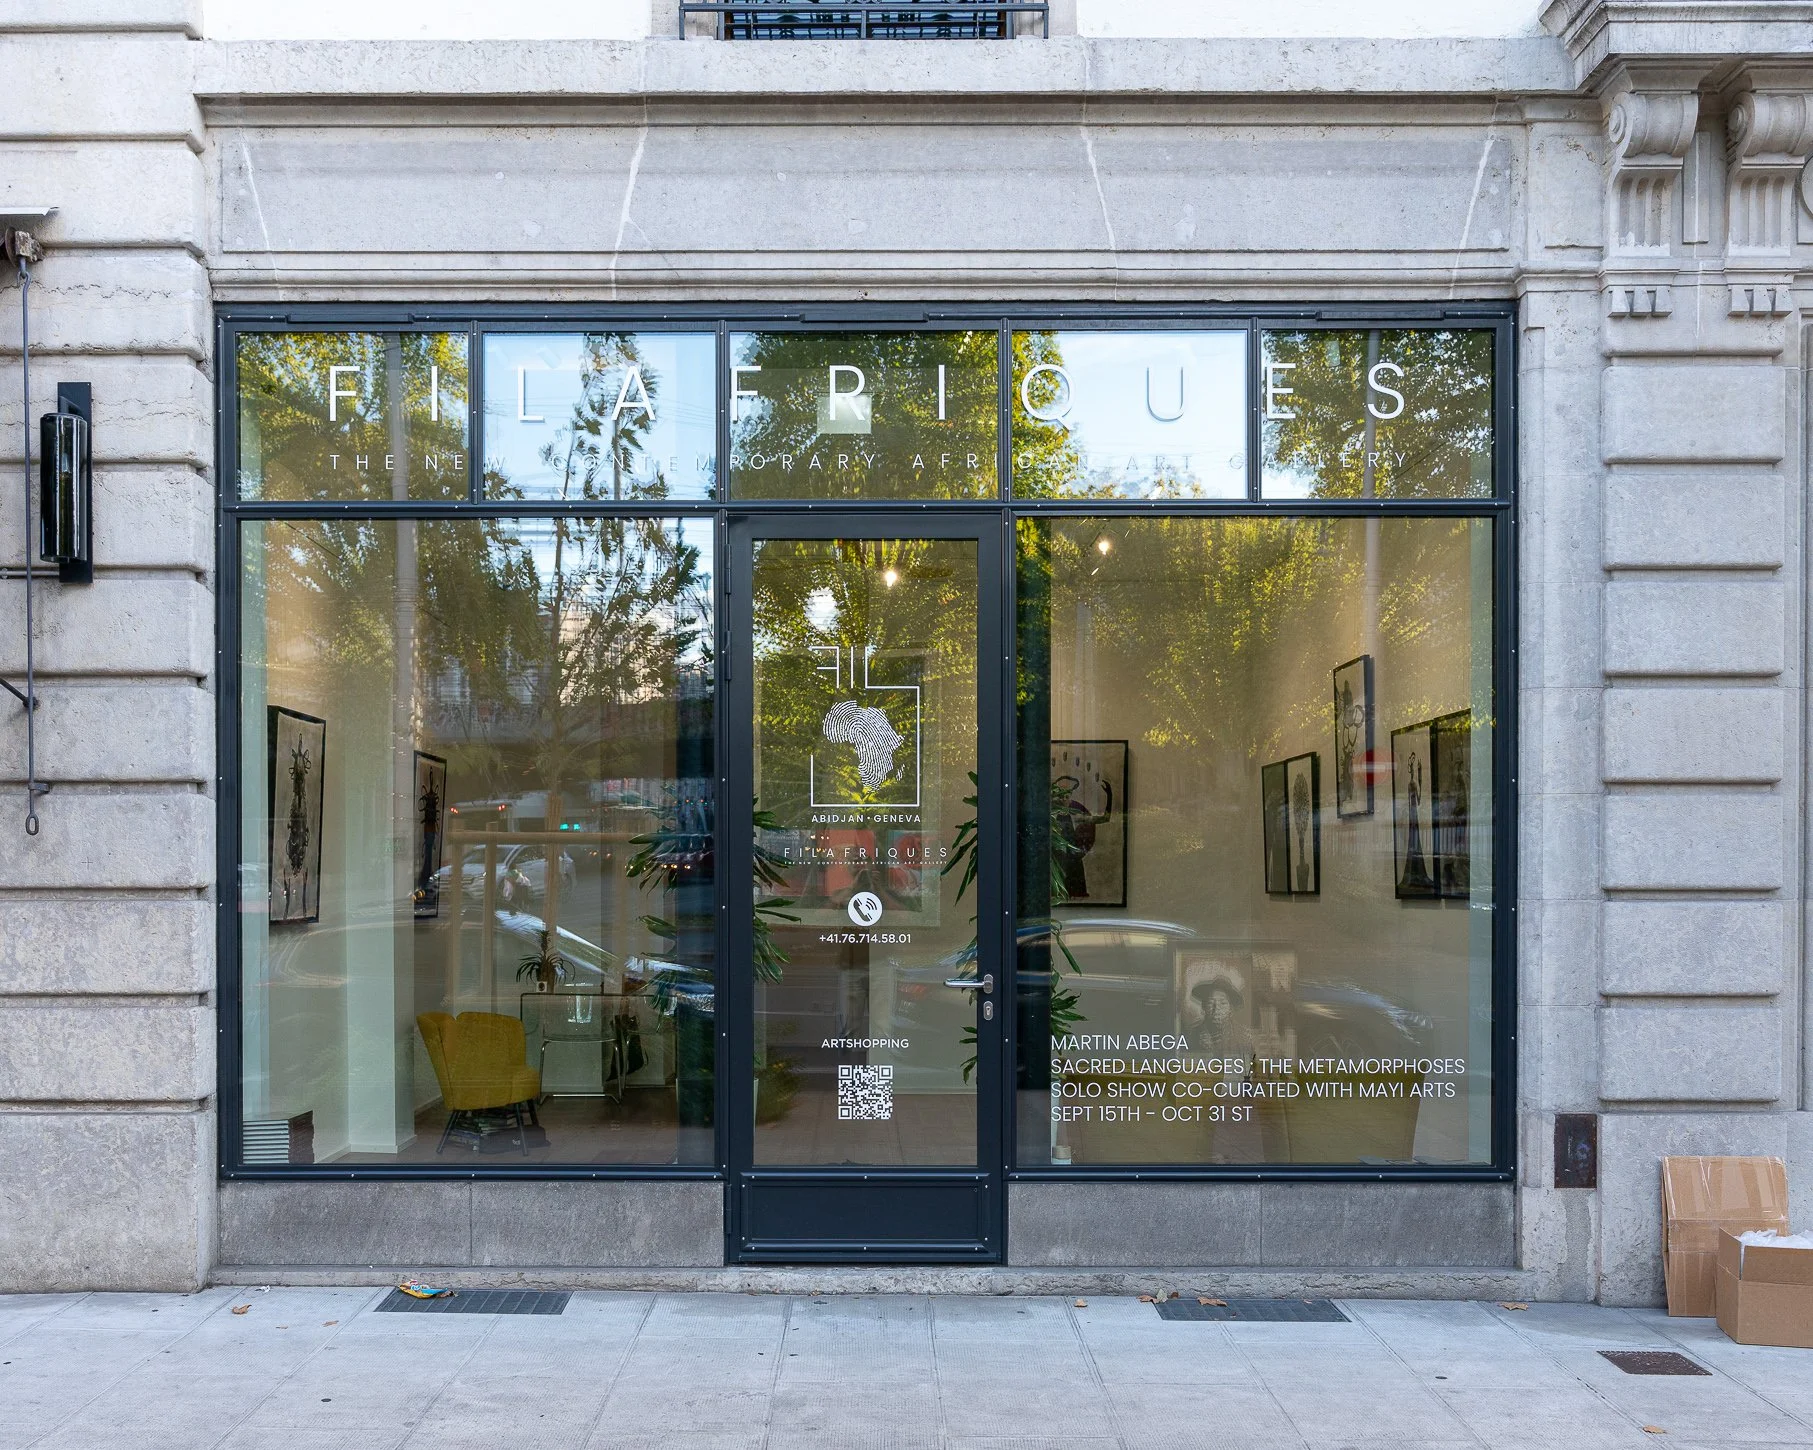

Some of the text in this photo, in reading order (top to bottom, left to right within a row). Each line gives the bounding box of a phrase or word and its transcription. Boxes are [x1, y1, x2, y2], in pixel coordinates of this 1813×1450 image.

[328, 363, 1407, 430] FILAFRIQUES
[329, 452, 1407, 471] THE NEW CONTEMPORARY AFRICAN ART GALLERY
[811, 814, 921, 823] ABIDJAN GENEVA
[784, 847, 947, 858] FILAFRIQUES
[819, 933, 912, 944] +41.76.714.58.01
[821, 1038, 909, 1049] ARTSHOPPING
[1050, 1034, 1189, 1051] MARTIN ABEGA
[1050, 1058, 1126, 1075] SACRED
[1131, 1058, 1244, 1075] LANGUAGES
[1258, 1058, 1293, 1075] THE
[1298, 1058, 1466, 1075] METAMORPHOSES
[1050, 1082, 1457, 1099] SOLO SHOW CO-CURATED WITH MAYI ARTS
[1050, 1105, 1094, 1122] SEPT
[1098, 1105, 1140, 1122] 15TH
[1161, 1105, 1201, 1122] OCT
[1208, 1105, 1226, 1122] 31
[1231, 1105, 1254, 1122] ST
